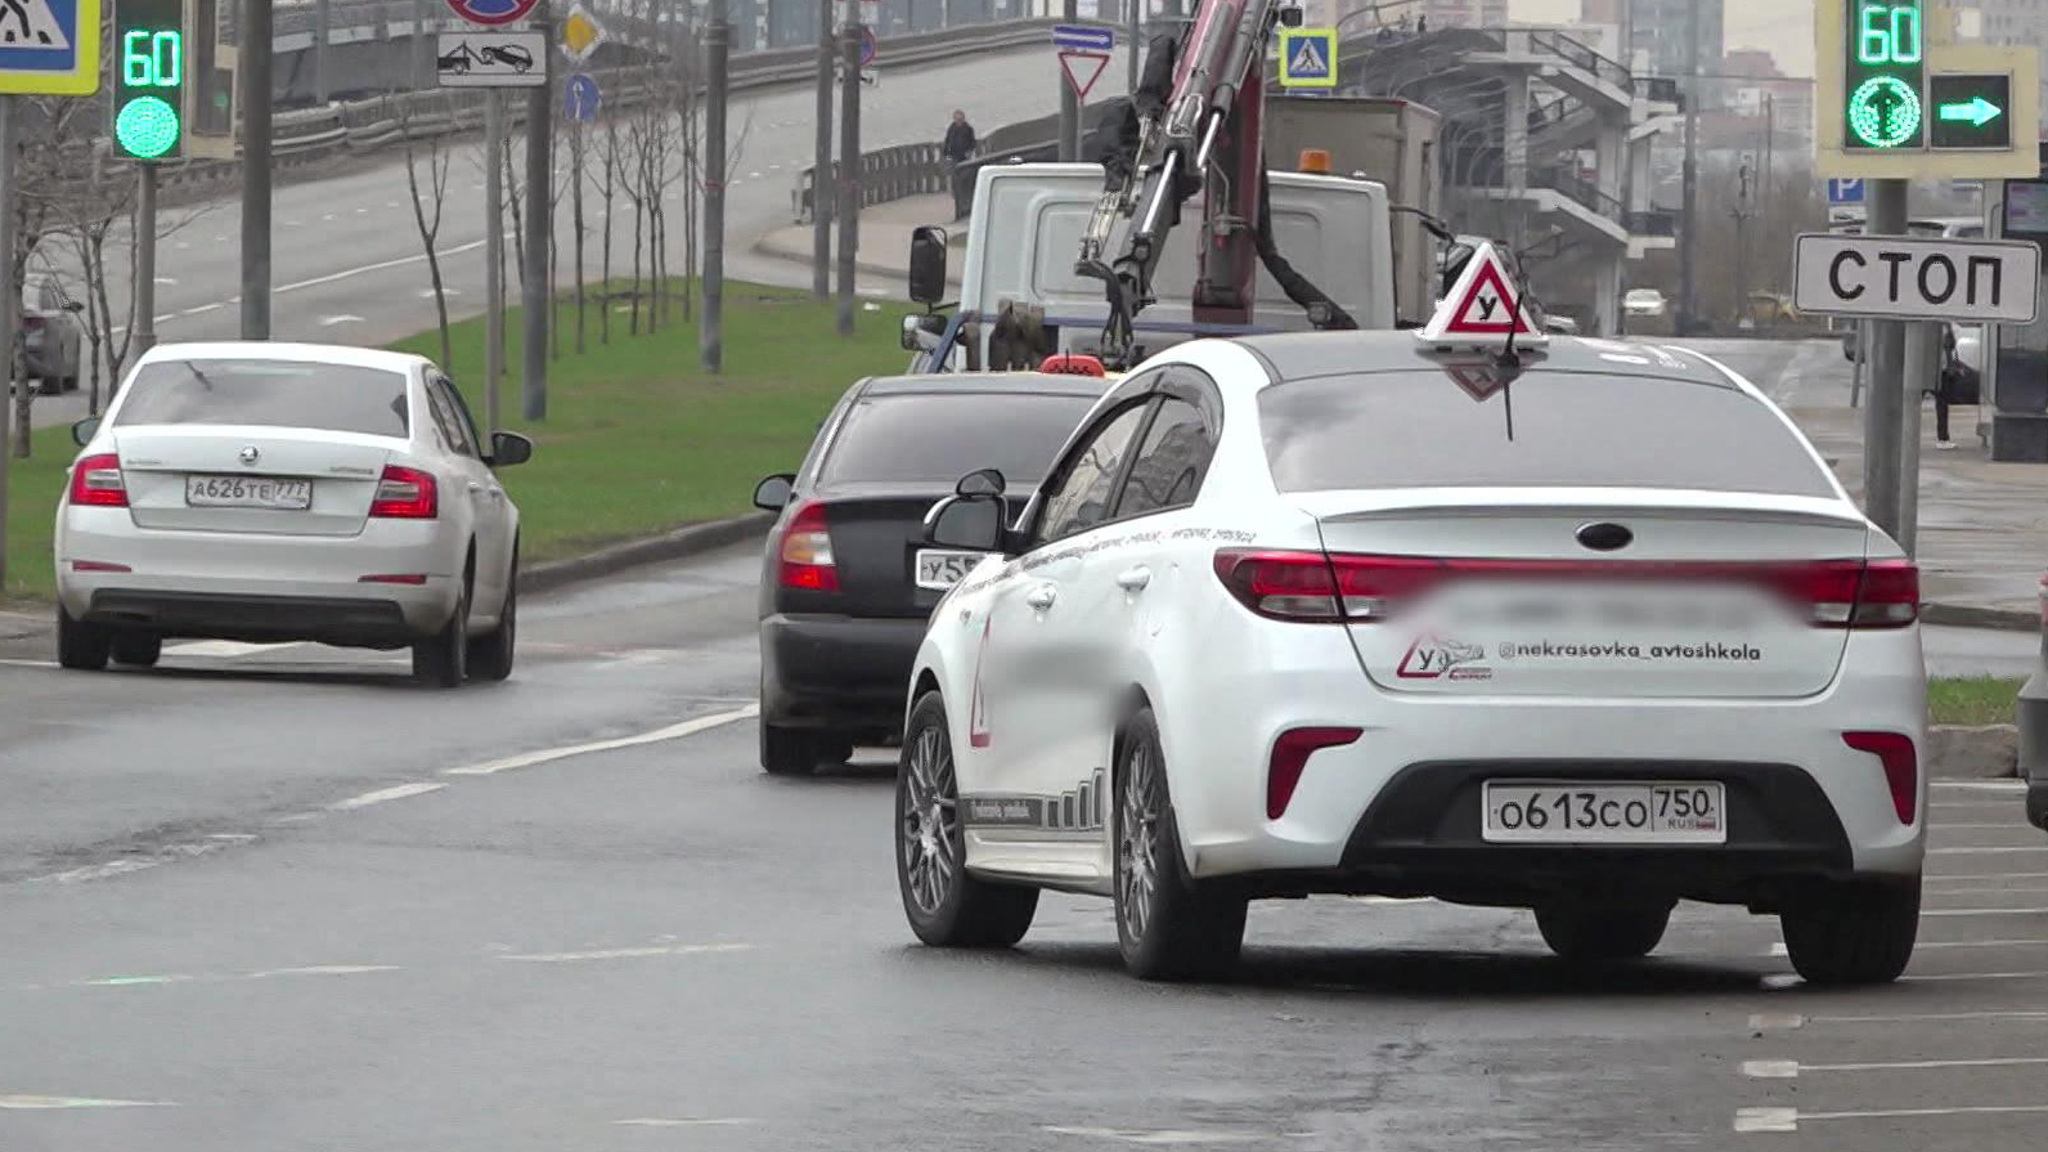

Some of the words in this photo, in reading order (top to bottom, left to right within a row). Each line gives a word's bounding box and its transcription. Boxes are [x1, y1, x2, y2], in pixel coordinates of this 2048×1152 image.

[124, 31, 180, 86] 60
[1859, 7, 1920, 62] 60
[1829, 250, 2002, 306] СТОП
[1478, 296, 1497, 320] У
[194, 479, 271, 499] А626ТЕ
[1500, 793, 1648, 830] О613СО
[1655, 788, 1709, 817] 750
